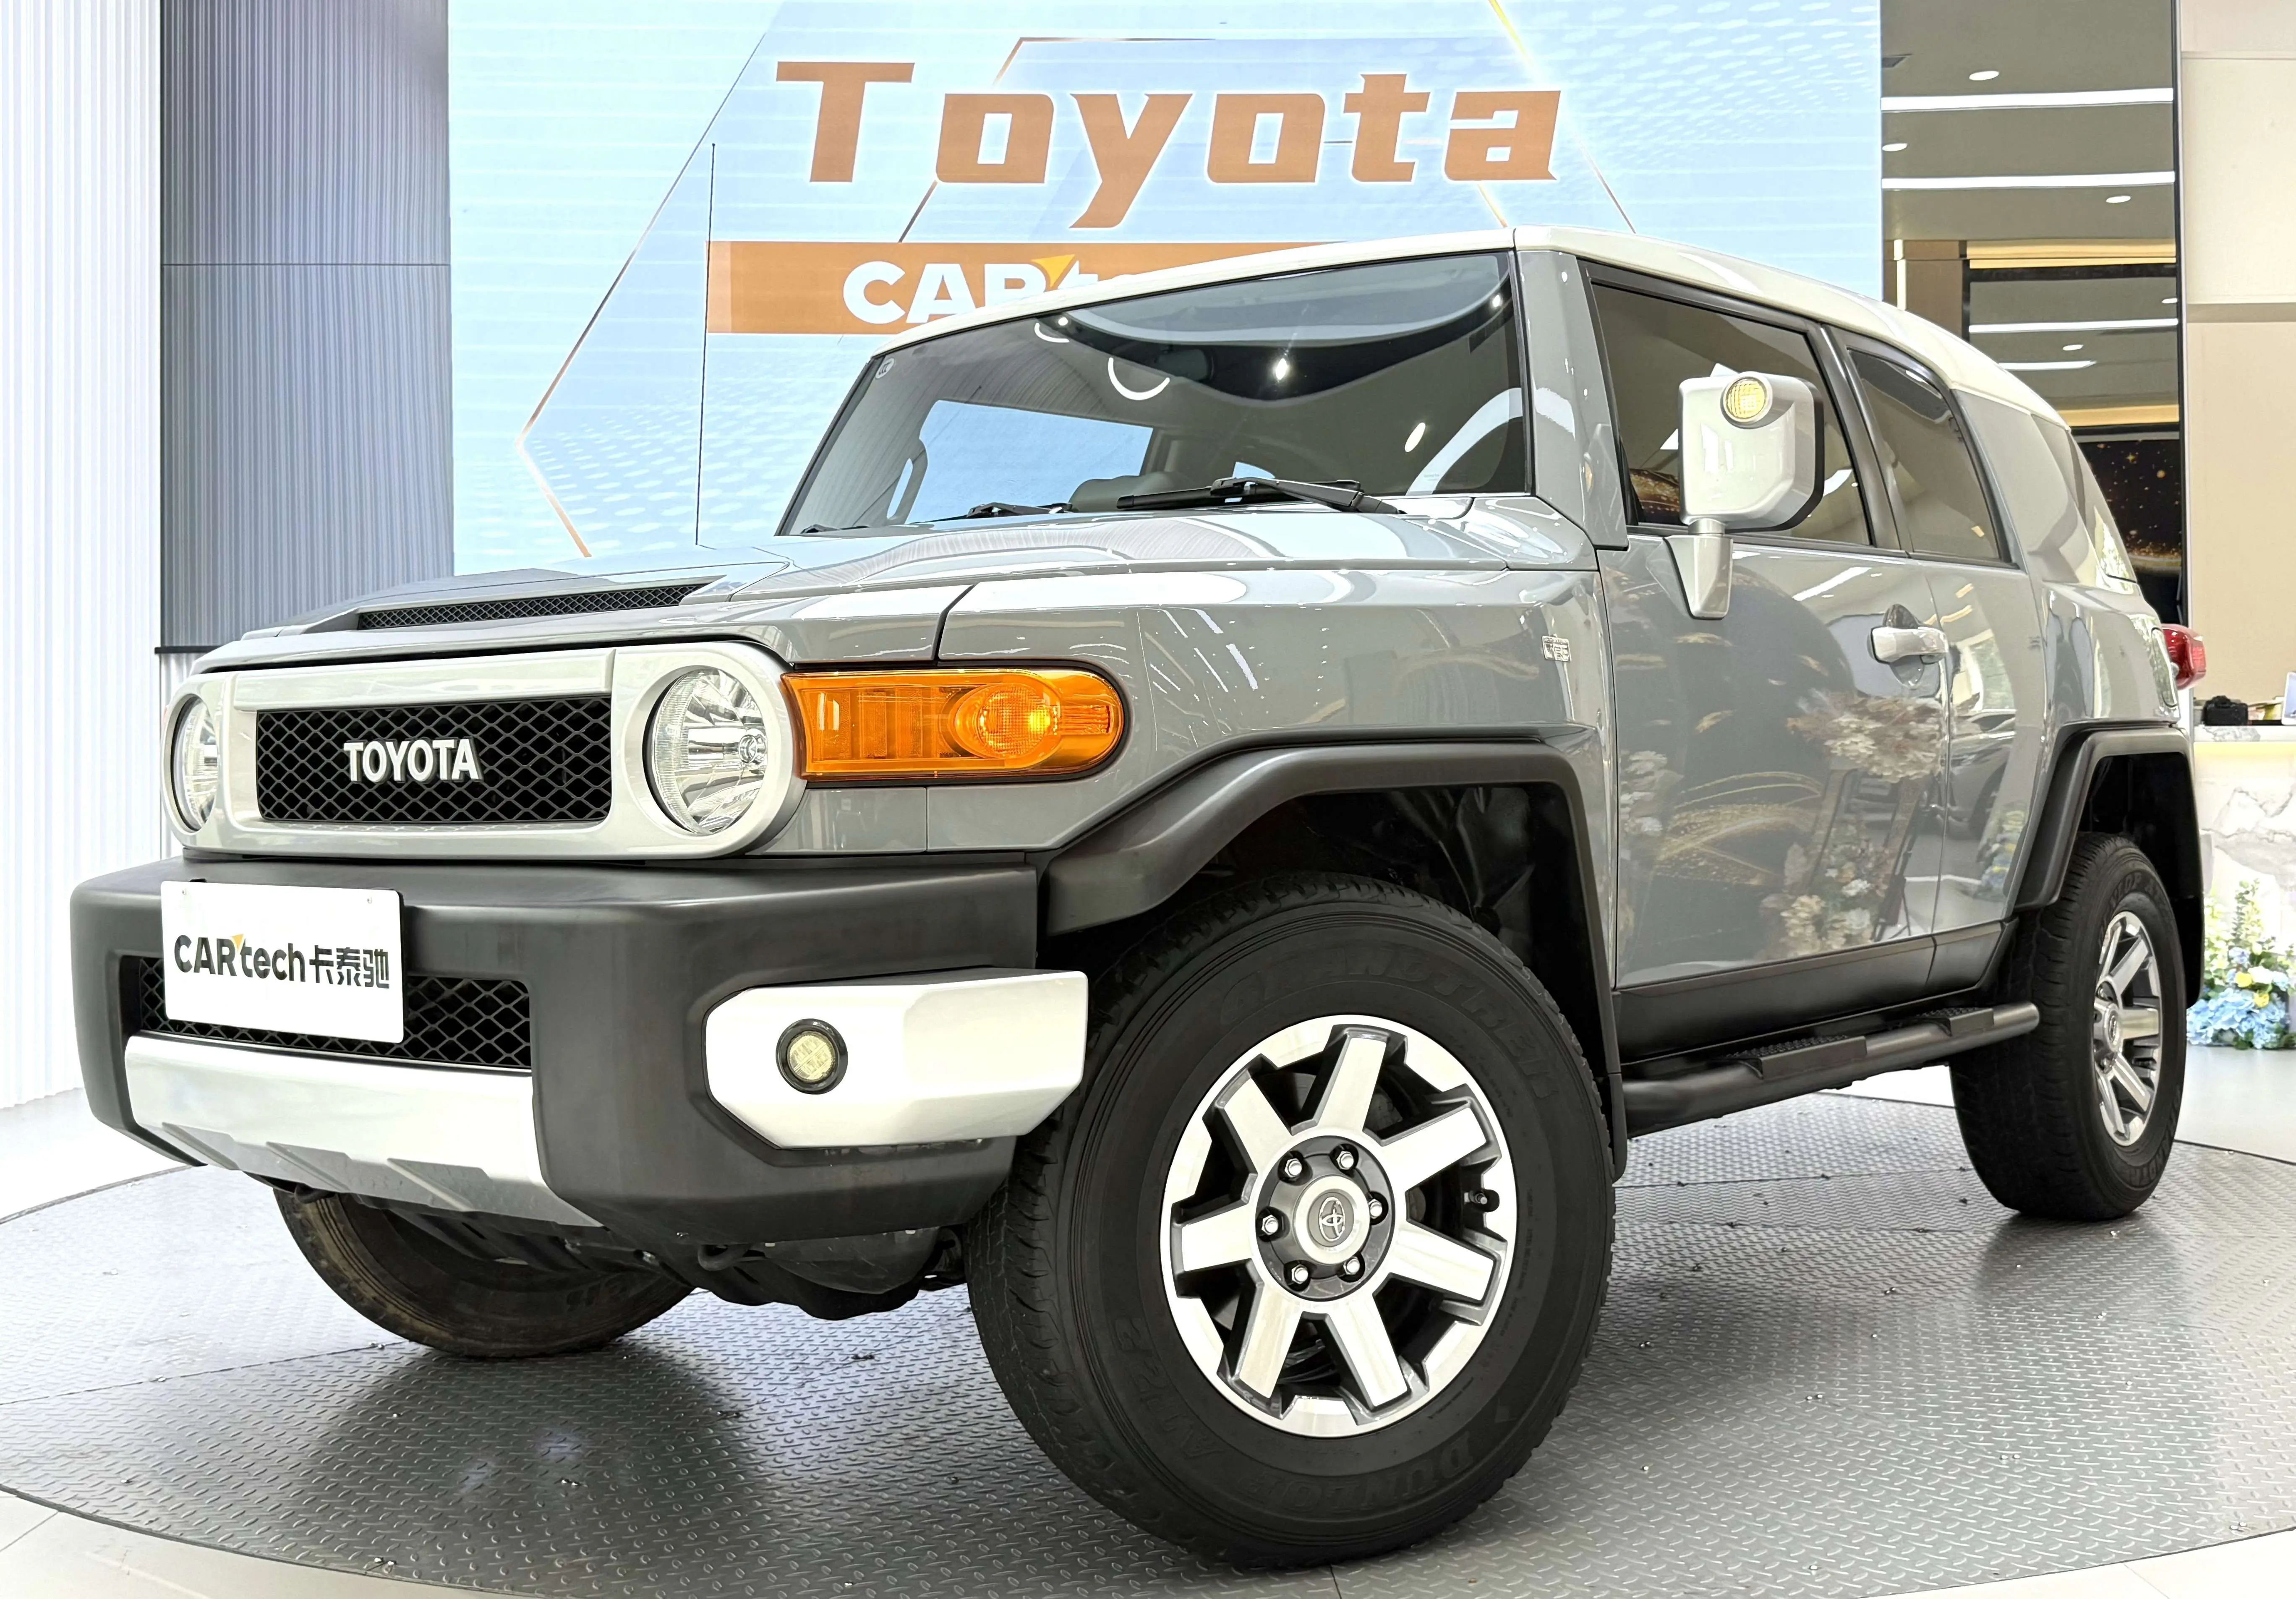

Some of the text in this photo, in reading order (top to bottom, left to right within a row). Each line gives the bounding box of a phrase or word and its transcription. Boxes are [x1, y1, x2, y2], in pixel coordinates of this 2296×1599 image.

[776, 61, 1561, 228] Toyota
[343, 738, 483, 783] TOYOTA
[174, 934, 389, 989] CARtech 卡泰驰
